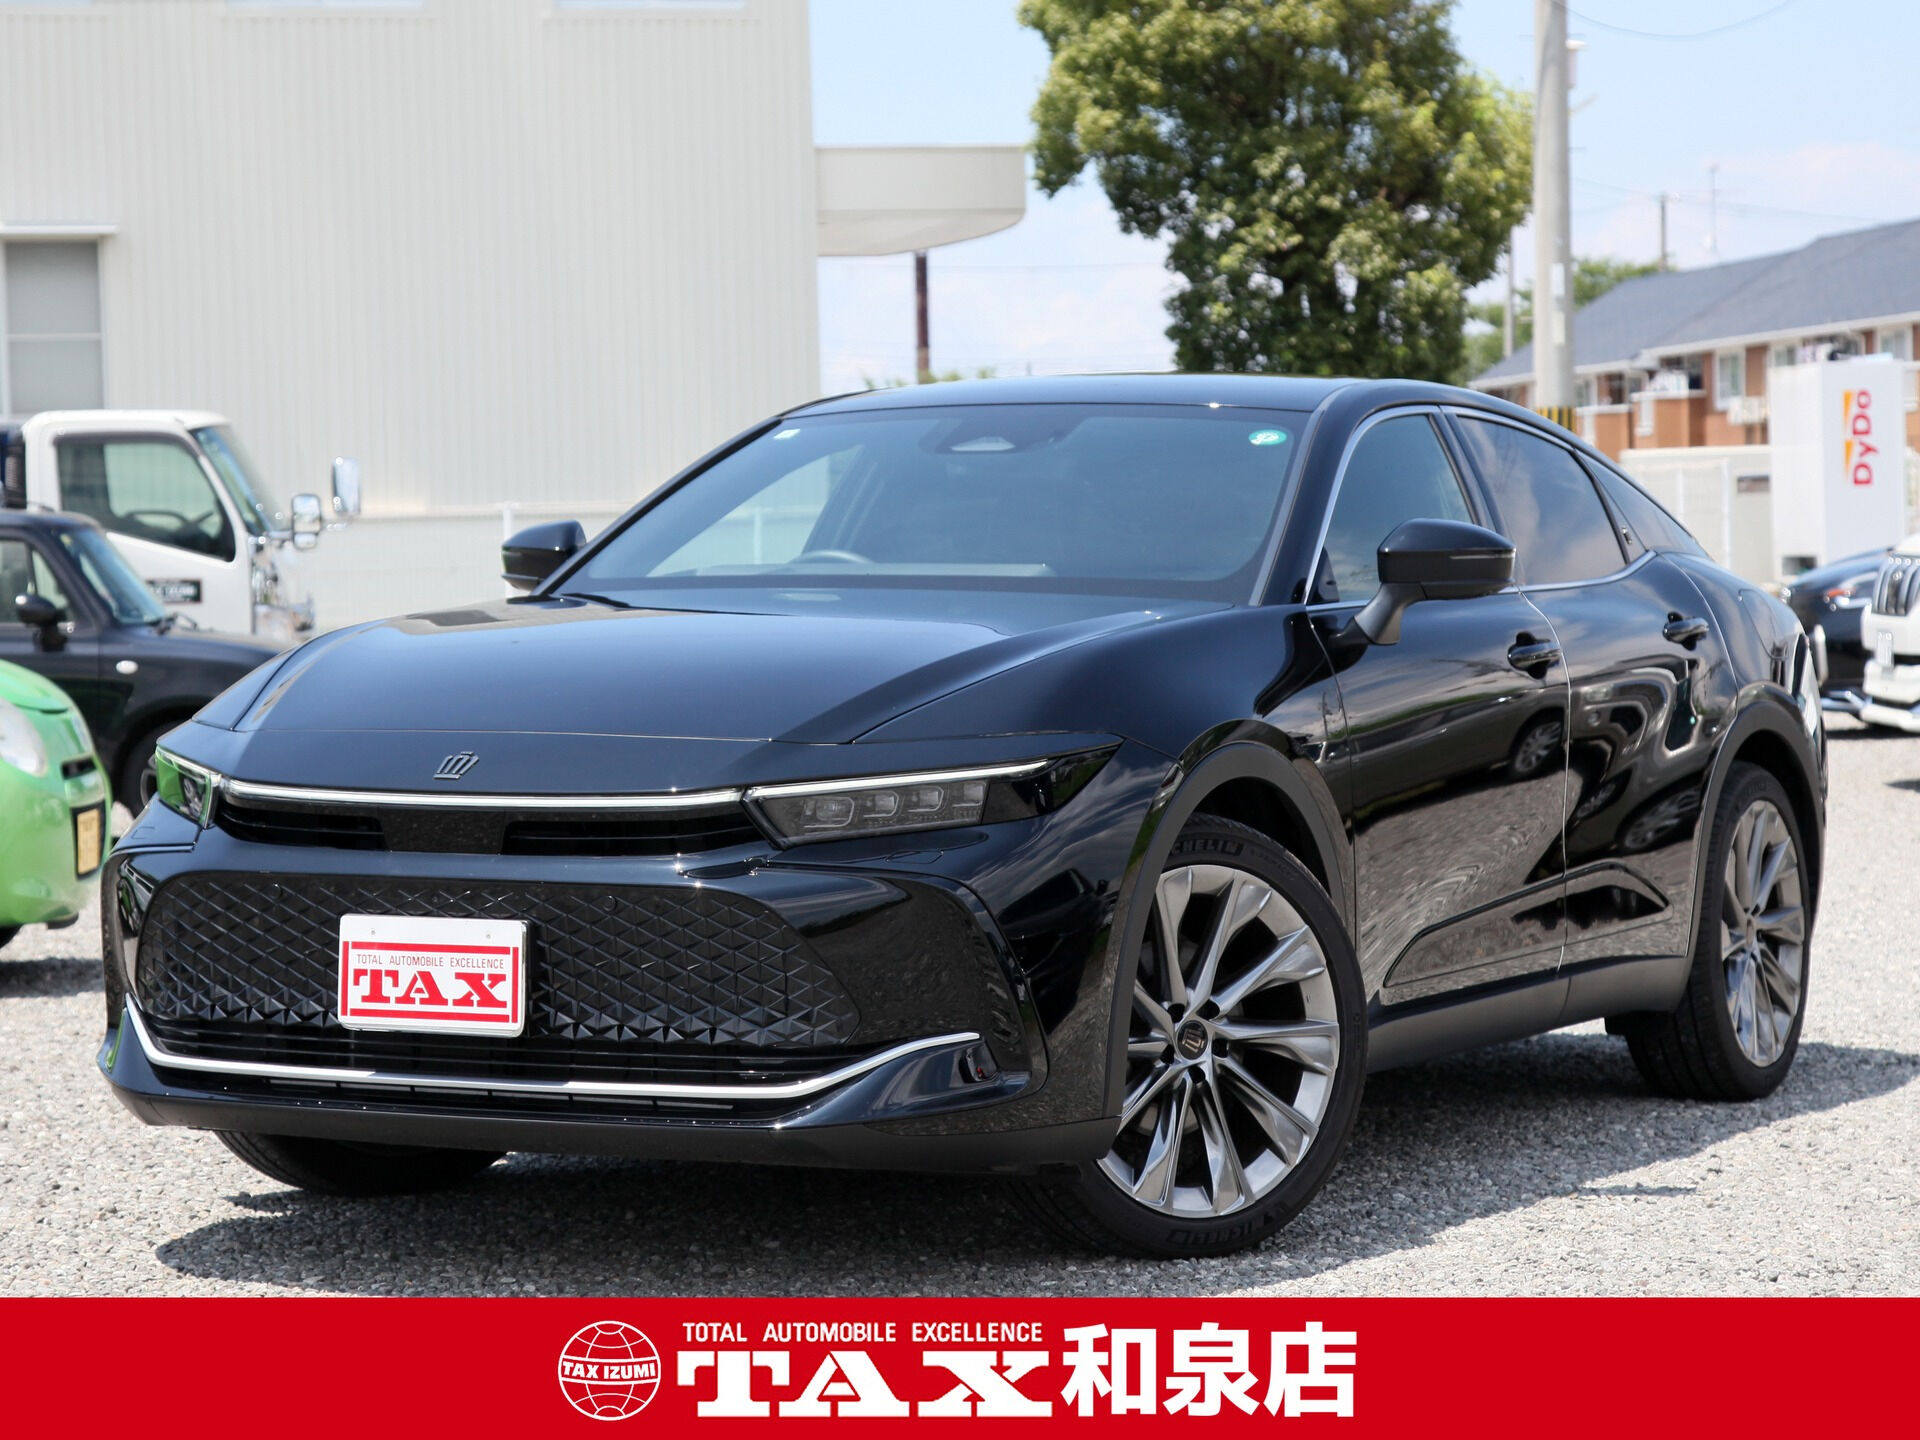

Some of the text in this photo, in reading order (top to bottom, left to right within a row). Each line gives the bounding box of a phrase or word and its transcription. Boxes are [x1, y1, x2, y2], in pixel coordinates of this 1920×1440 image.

[1171, 838, 1241, 856] CHELIN
[357, 954, 504, 969] TOTAL AUTOMOBILE EXCELLENCE
[353, 968, 507, 1009] TAX
